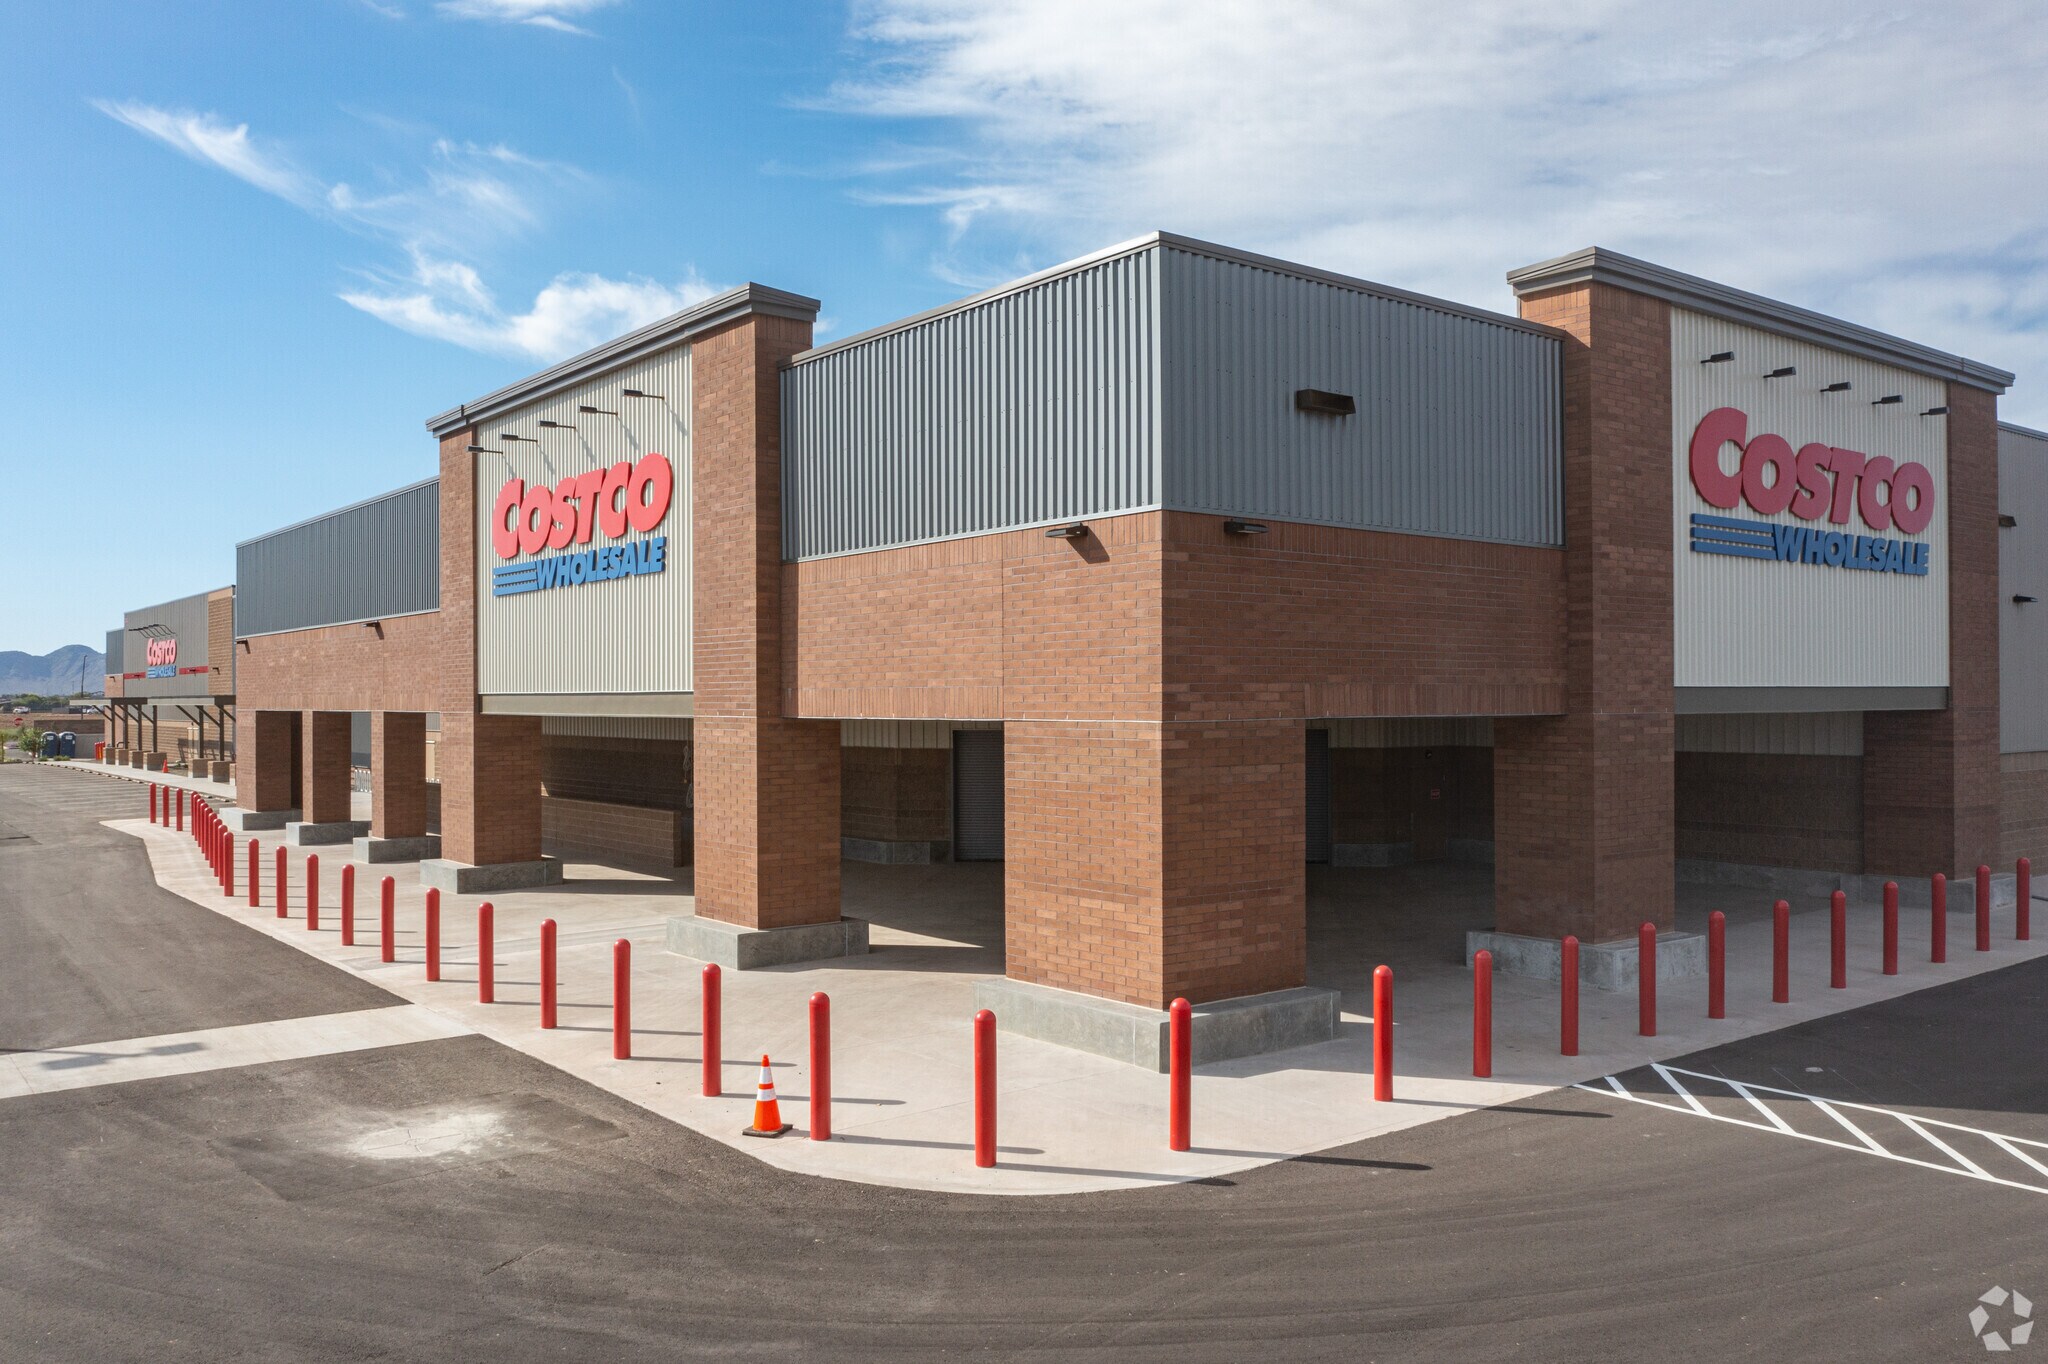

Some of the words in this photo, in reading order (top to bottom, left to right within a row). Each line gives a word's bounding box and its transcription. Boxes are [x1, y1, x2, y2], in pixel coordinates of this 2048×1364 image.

[1690, 407, 1934, 534] COSTCO
[493, 453, 673, 559] COSTCO
[536, 536, 667, 590] WHOLESALE
[1772, 523, 1930, 576] WHOLESALE
[147, 638, 177, 666] COSTCO
